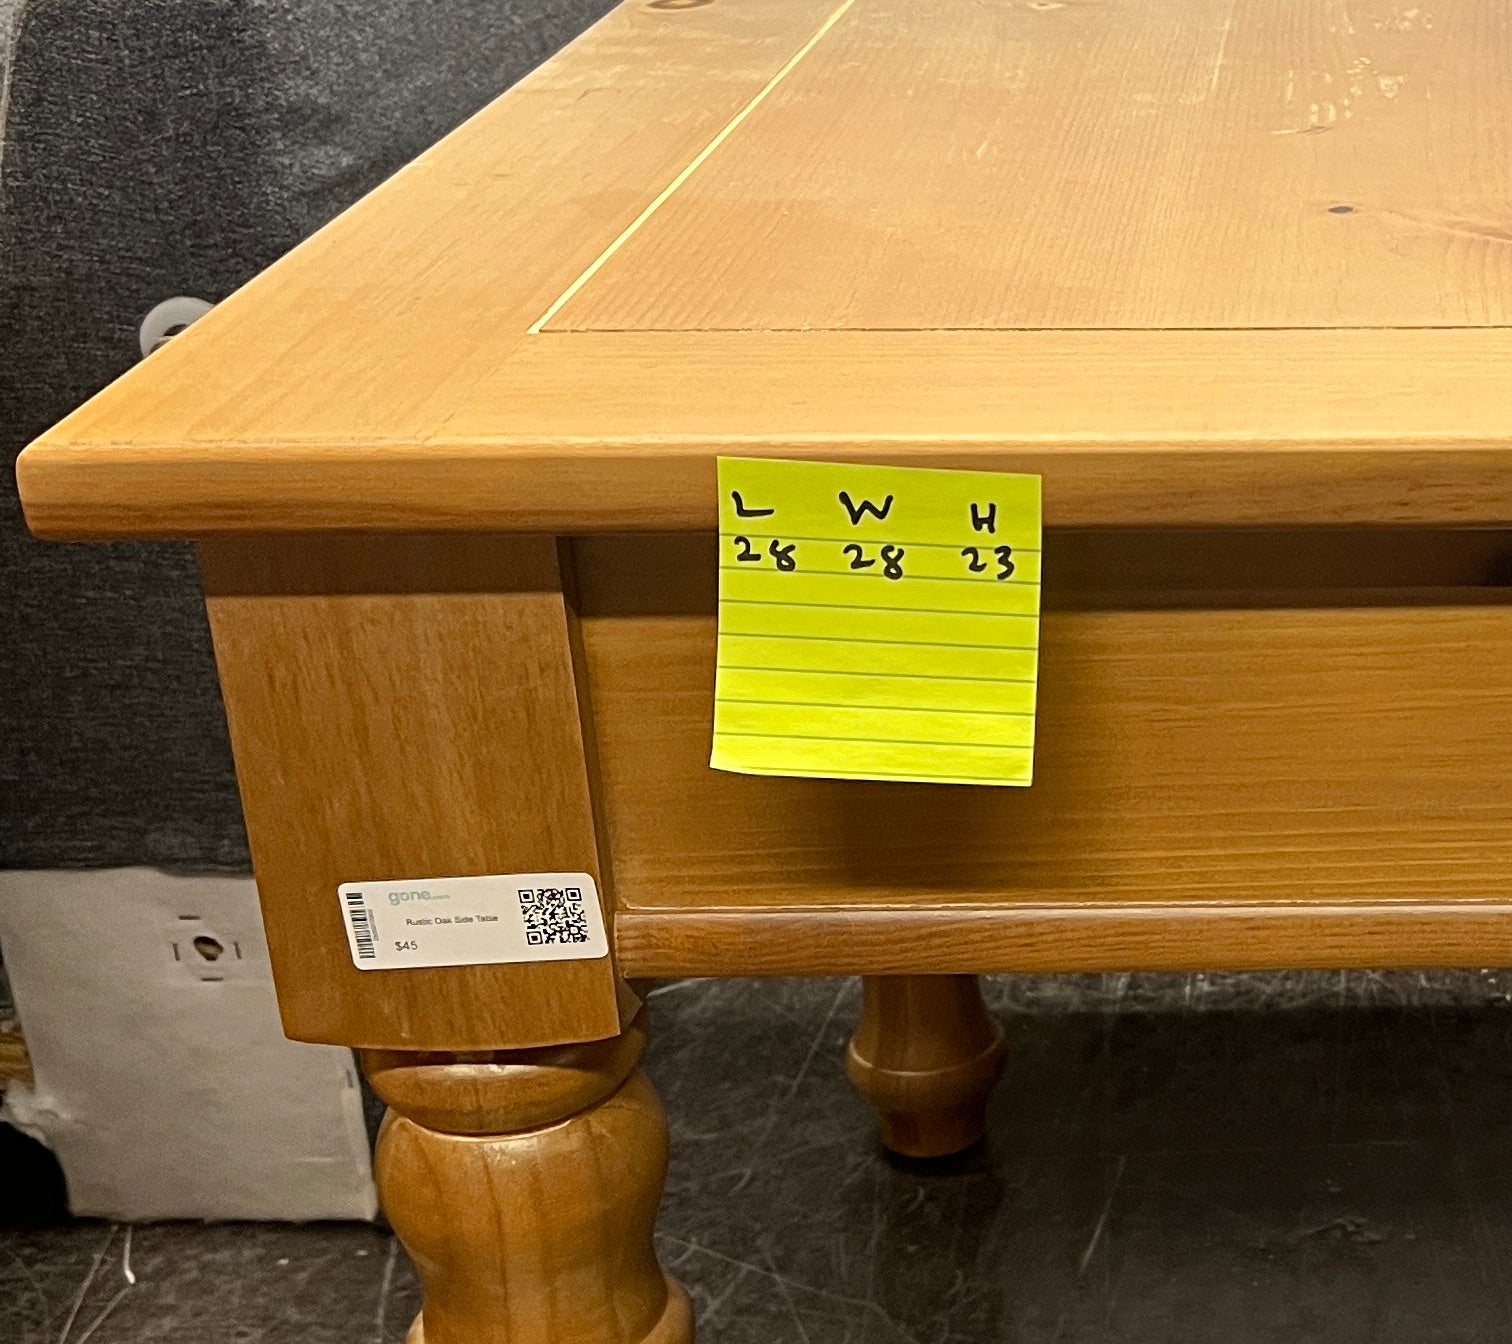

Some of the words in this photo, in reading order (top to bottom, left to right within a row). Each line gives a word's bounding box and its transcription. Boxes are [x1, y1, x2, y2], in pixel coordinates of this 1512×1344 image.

[732, 491, 775, 518] L
[838, 491, 894, 526] W
[970, 502, 997, 534] H
[733, 535, 796, 572] 28
[842, 543, 905, 580] 28
[961, 545, 1015, 581] 23
[434, 917, 453, 925] Oak
[454, 916, 474, 924] Side
[395, 941, 418, 952] $45
